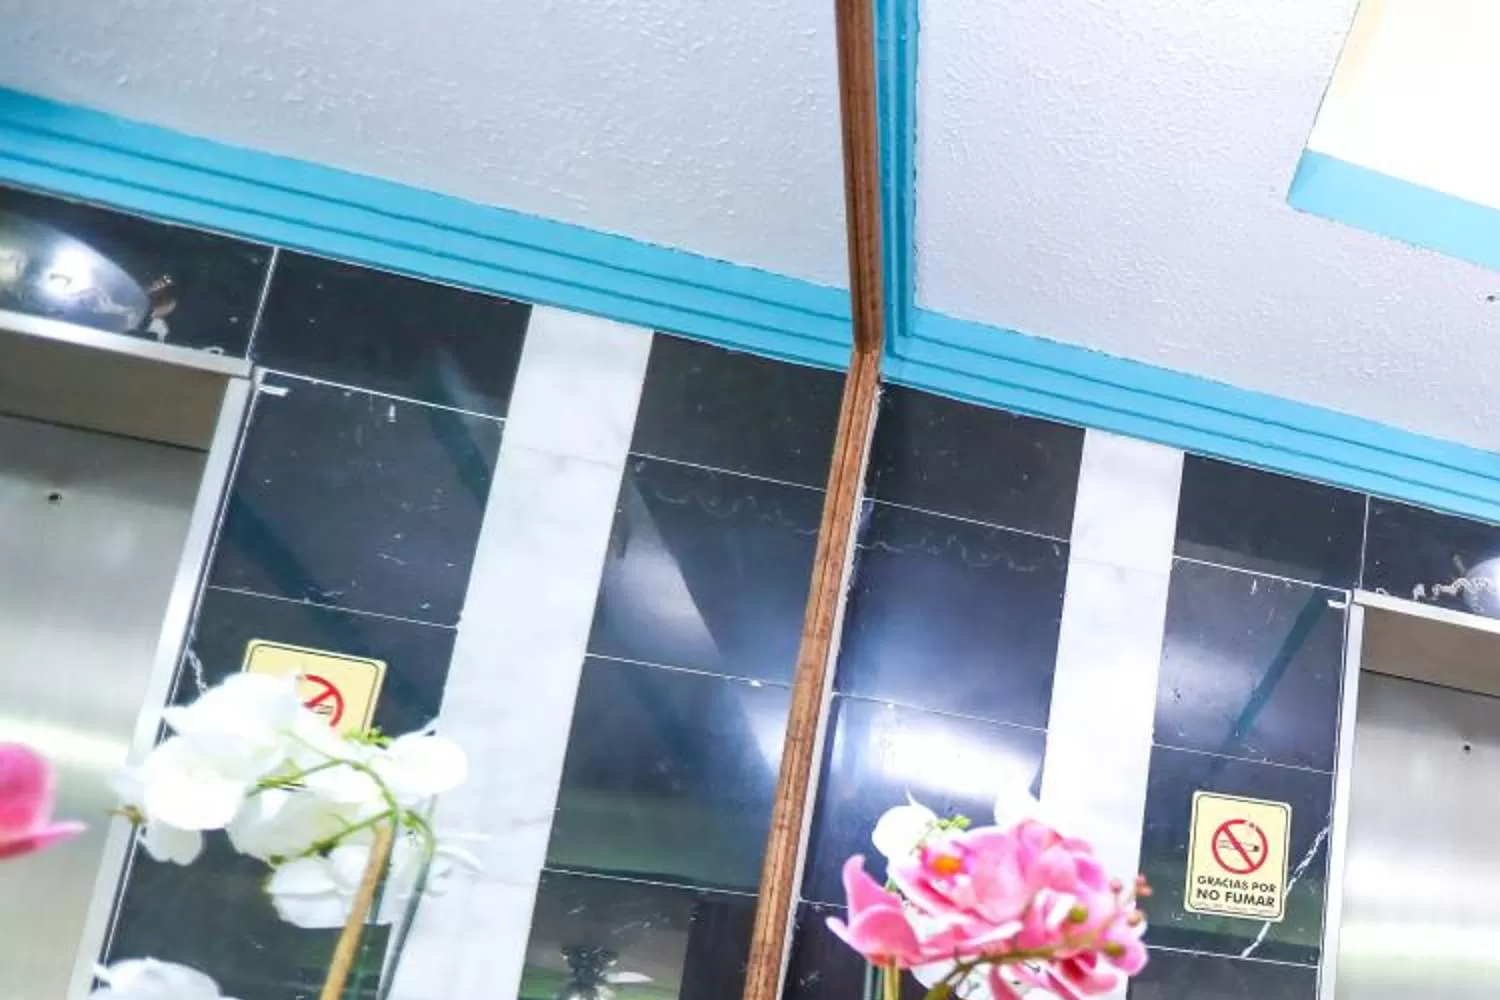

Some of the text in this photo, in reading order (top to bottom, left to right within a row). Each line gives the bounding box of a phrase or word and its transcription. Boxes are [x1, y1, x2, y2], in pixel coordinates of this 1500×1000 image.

[1197, 875, 1276, 893] GRACIAS POR
[1196, 888, 1275, 907] NO FUMAR
